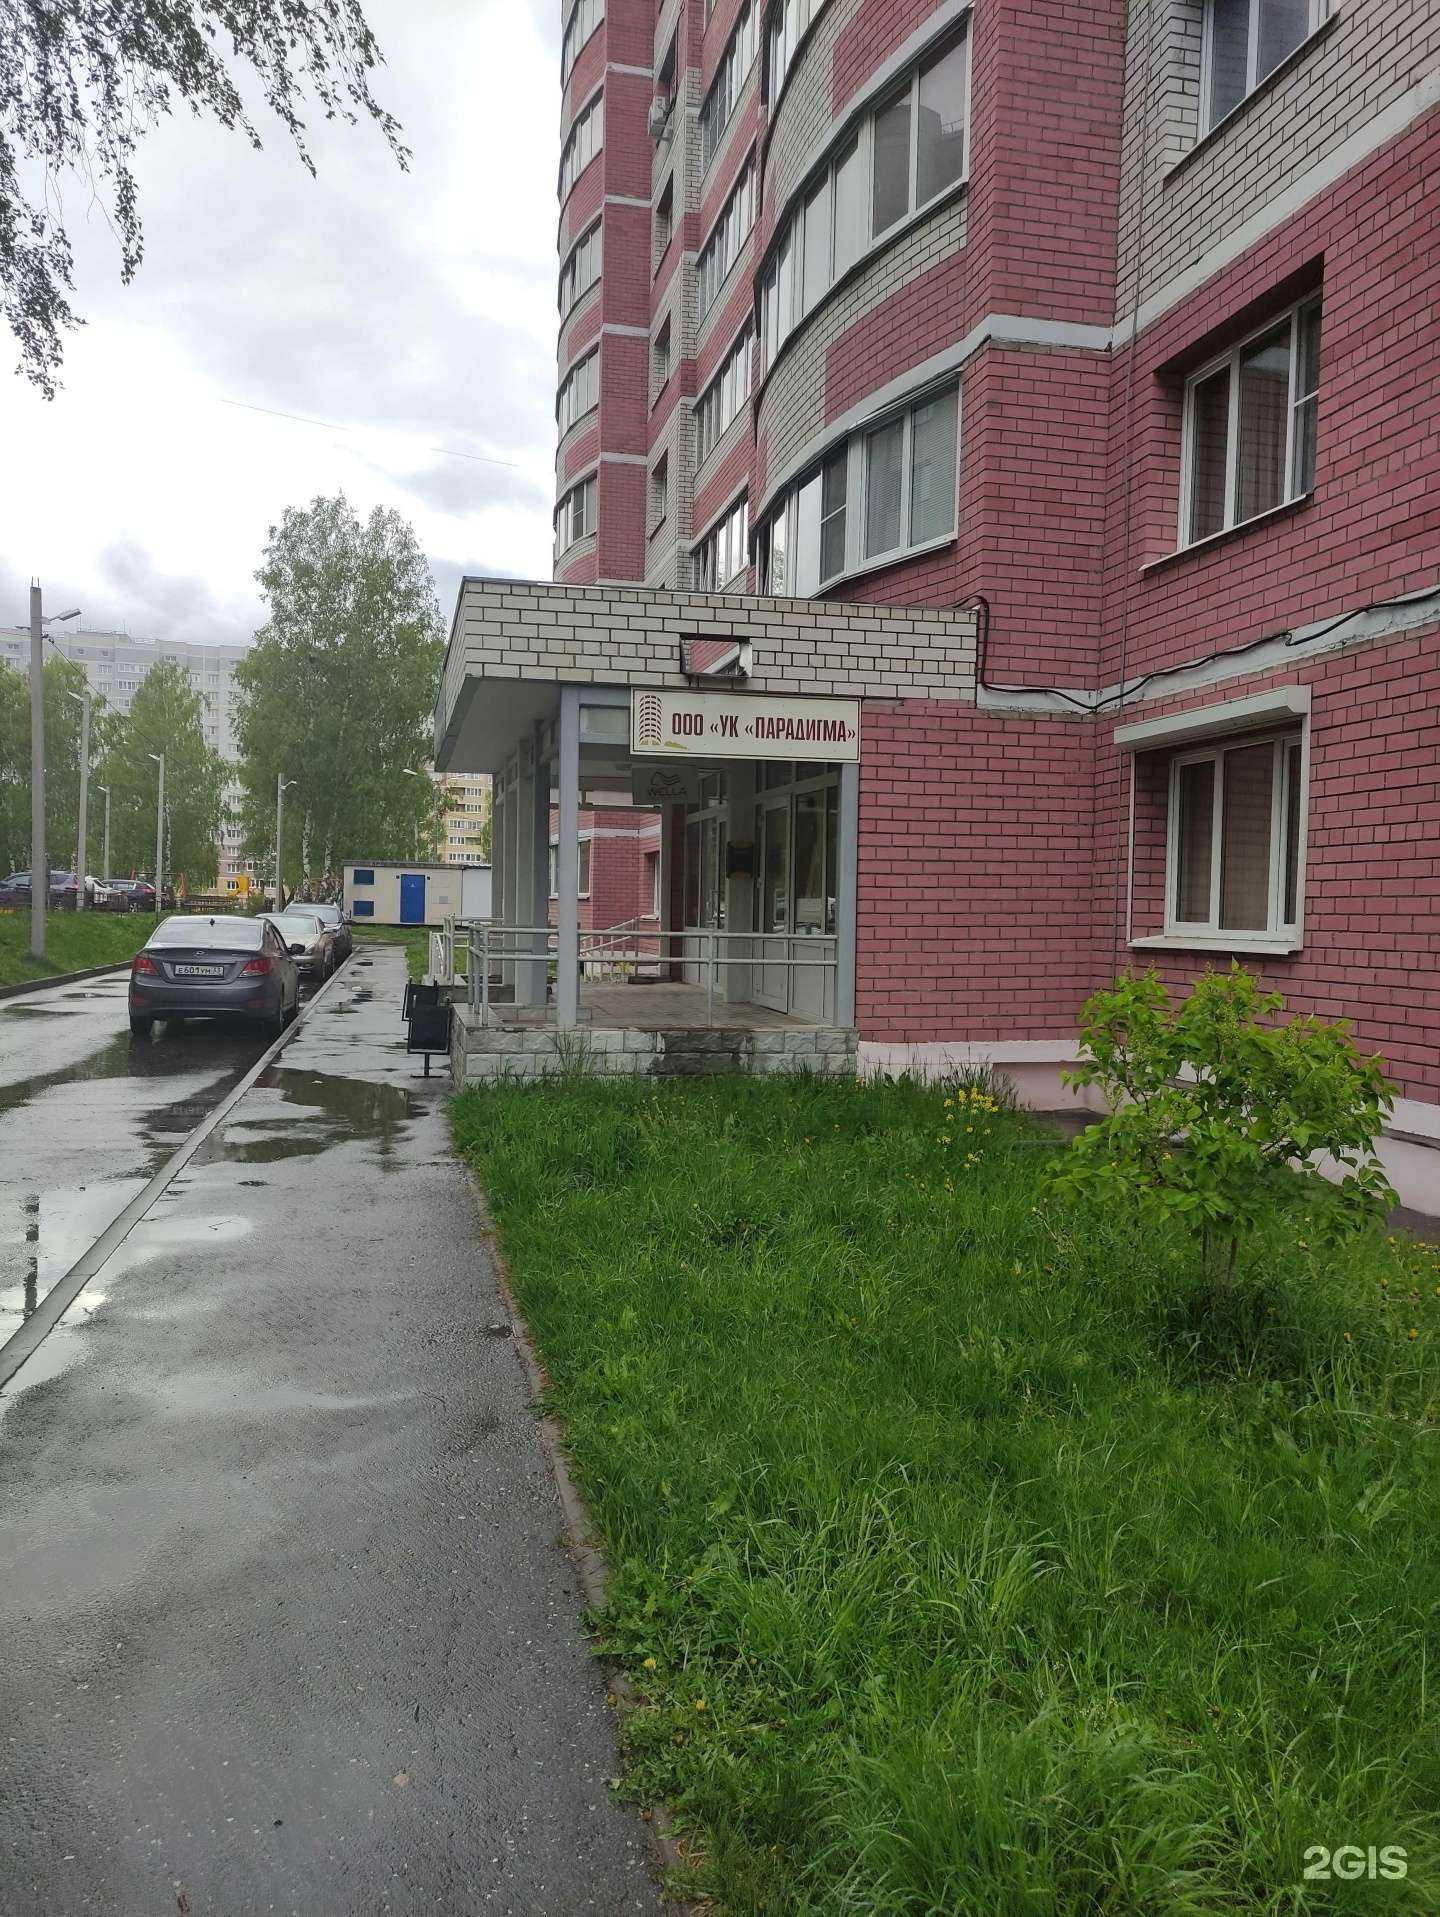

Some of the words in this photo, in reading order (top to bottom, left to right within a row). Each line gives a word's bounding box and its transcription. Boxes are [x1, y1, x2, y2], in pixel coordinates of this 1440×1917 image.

[671, 712, 704, 736] ООО
[710, 714, 740, 738] «УК
[744, 716, 856, 742] «ПАРАДИГМА»
